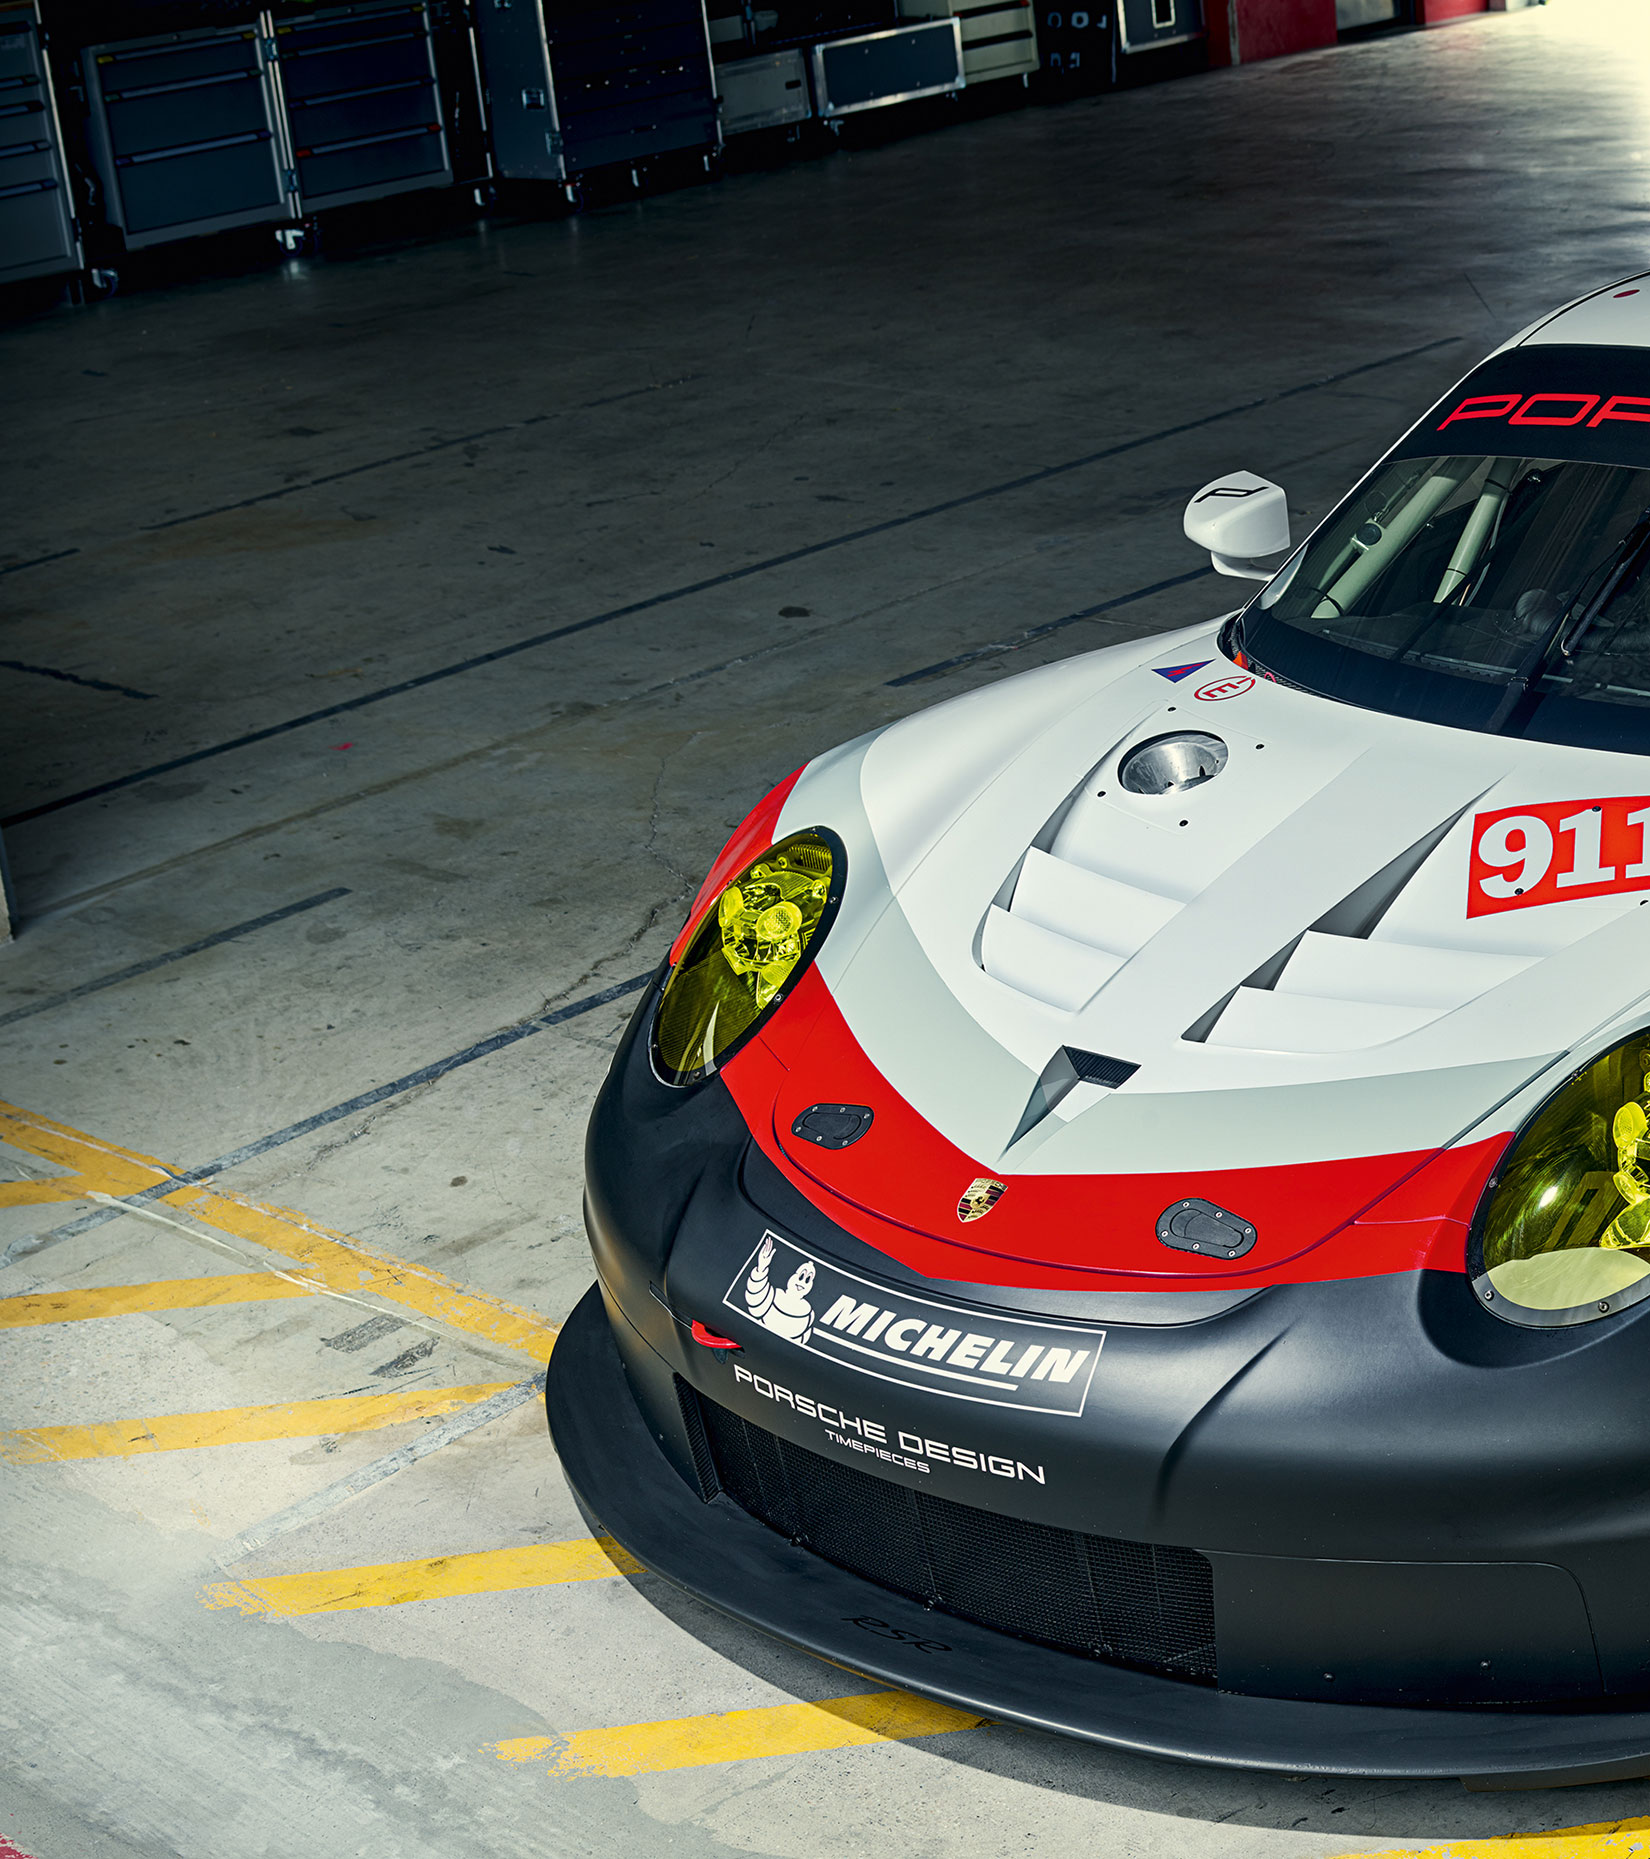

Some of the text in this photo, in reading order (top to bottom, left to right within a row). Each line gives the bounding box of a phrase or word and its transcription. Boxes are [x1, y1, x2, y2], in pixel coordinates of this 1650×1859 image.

[820, 1294, 1091, 1384] MICHELIN
[733, 1363, 1046, 1485] PORSCHE DESIGN
[824, 1429, 931, 1475] TIMEPIECES
[840, 1614, 953, 1654] RSR
